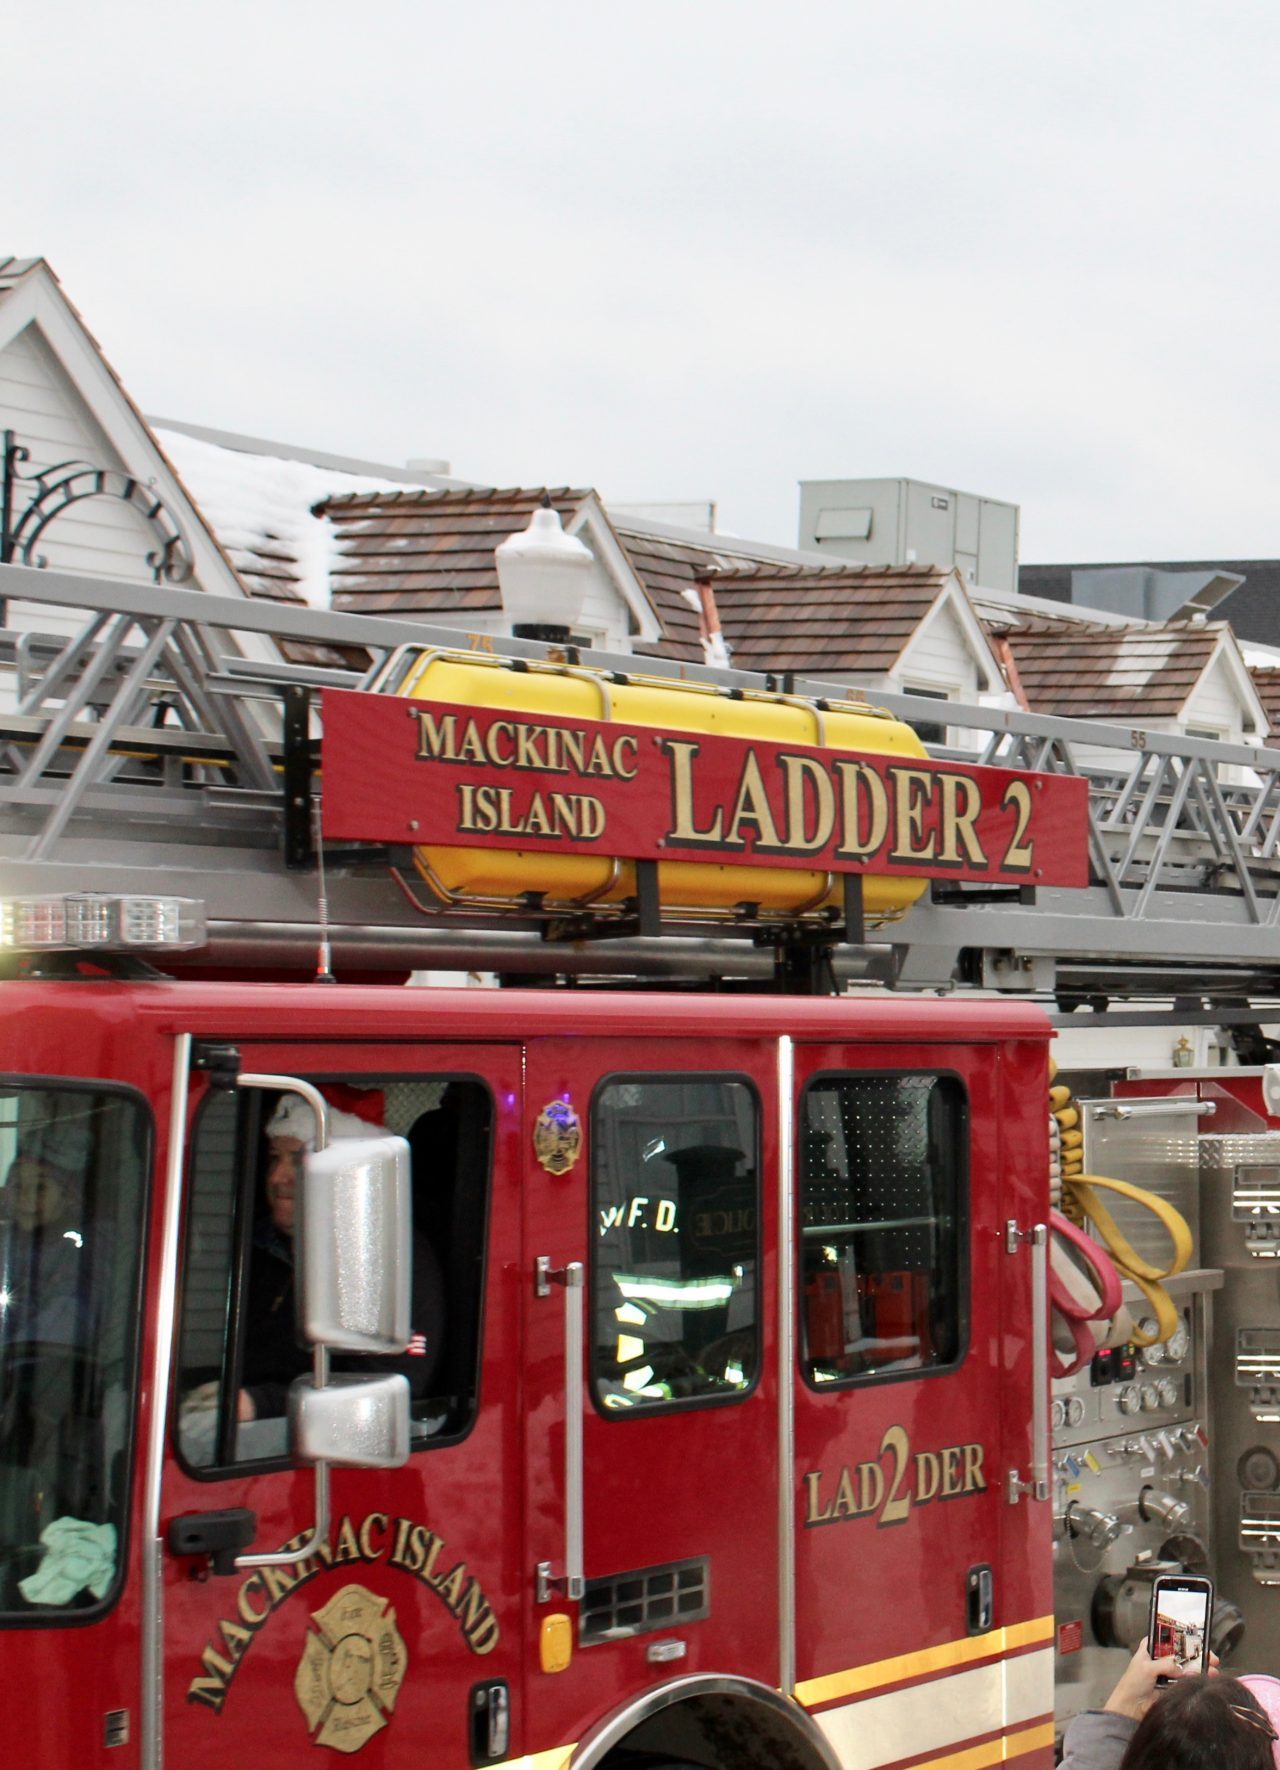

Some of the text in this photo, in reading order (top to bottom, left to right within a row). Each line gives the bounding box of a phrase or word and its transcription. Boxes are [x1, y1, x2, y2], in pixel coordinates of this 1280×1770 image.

[416, 711, 639, 781] MACKINAC
[1130, 729, 1146, 750] 55
[456, 784, 607, 841] ISLAND
[660, 739, 1035, 874] LADDER 2
[388, 1516, 500, 1656] ISLAND
